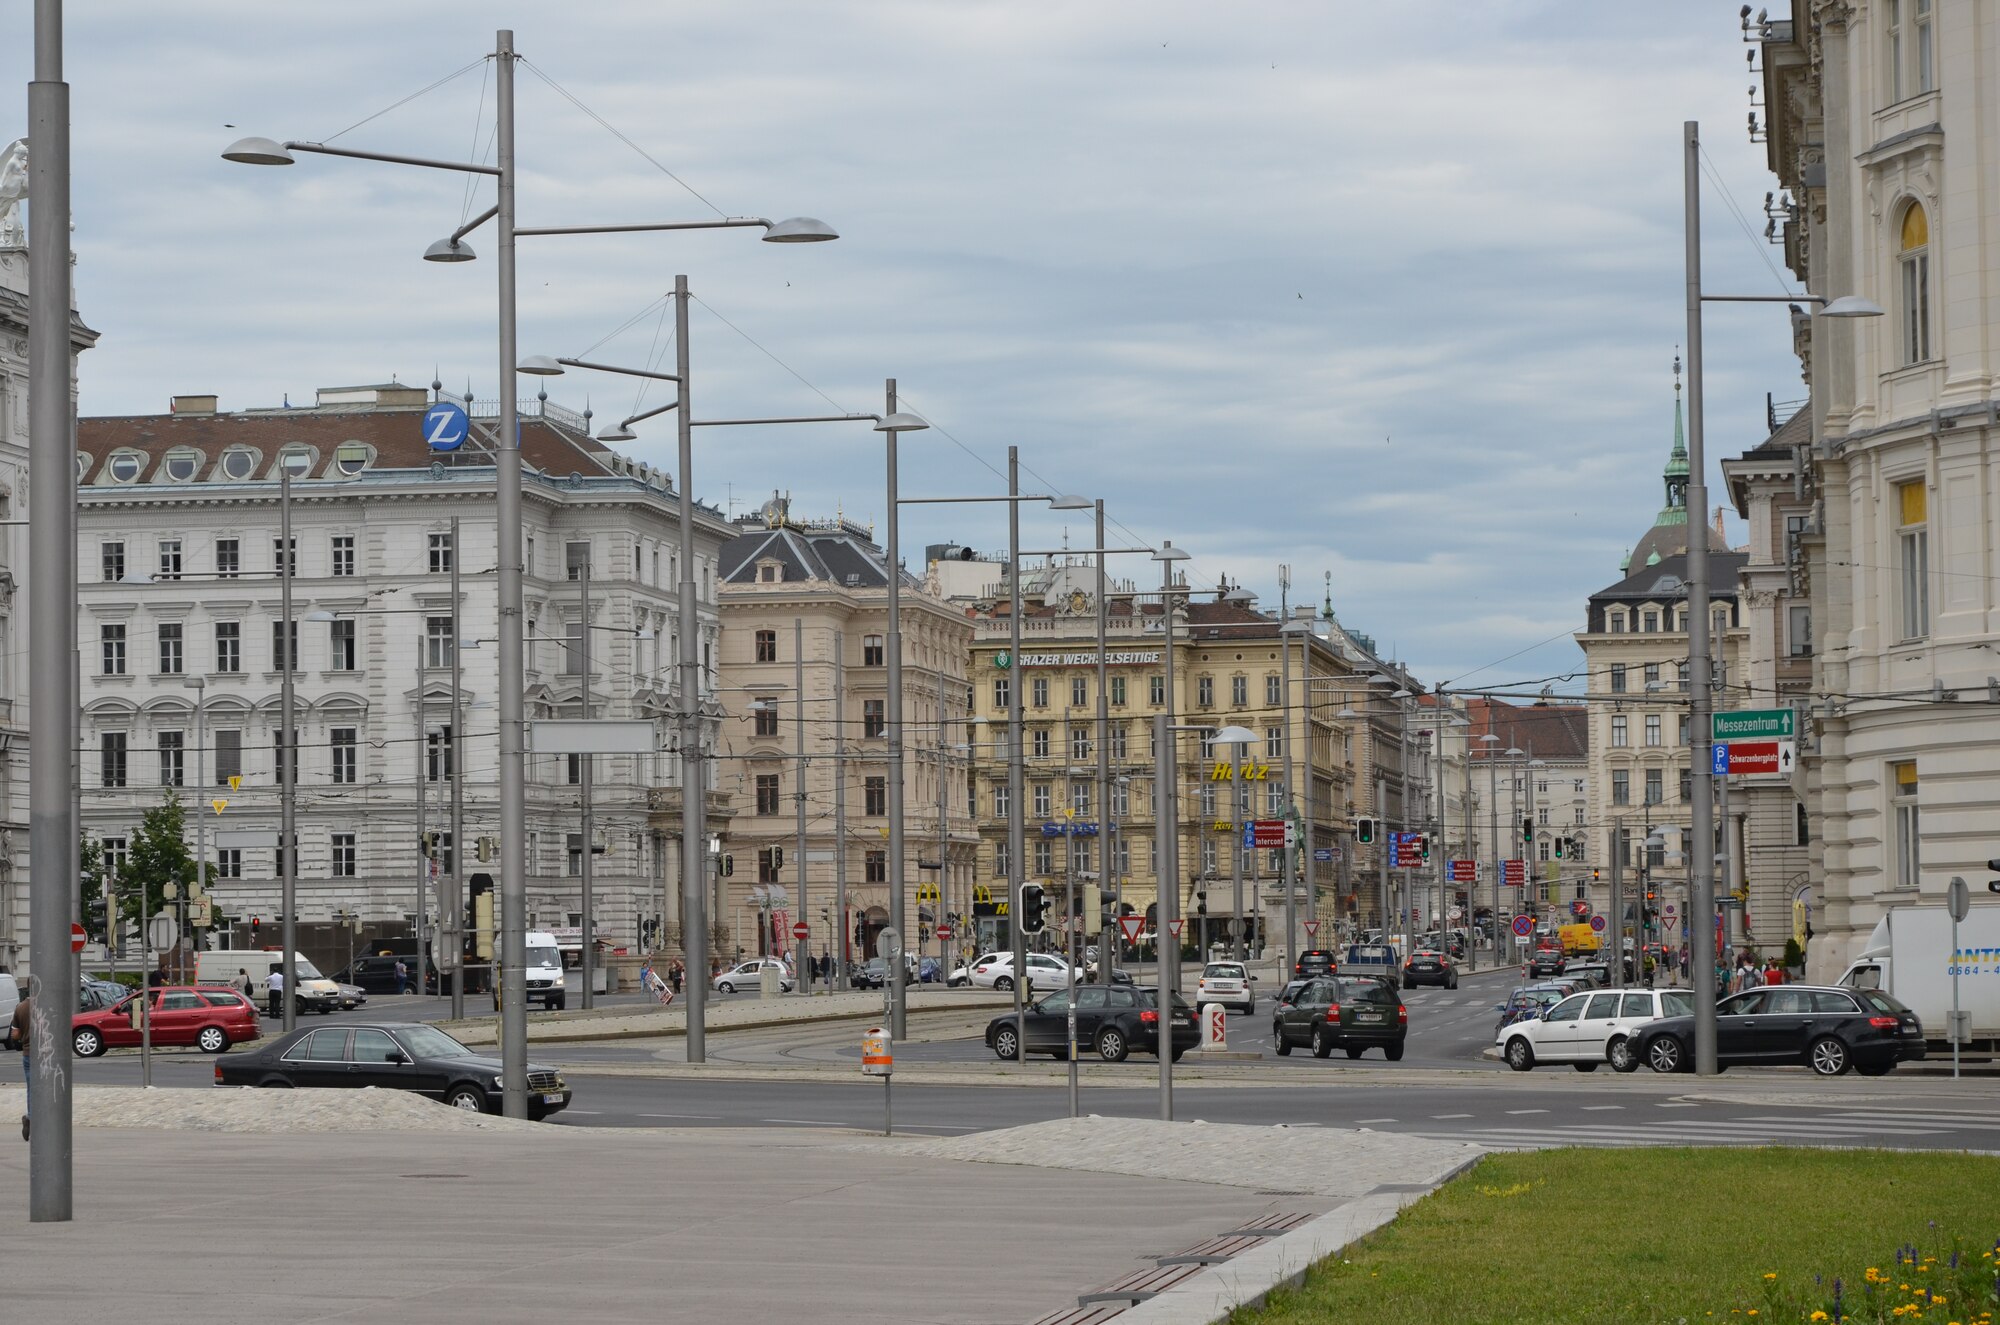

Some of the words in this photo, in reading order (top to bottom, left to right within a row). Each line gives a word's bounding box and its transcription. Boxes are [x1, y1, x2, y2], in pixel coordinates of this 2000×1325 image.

[427, 410, 461, 443] Z
[1716, 716, 1778, 733] Messezentrum
[1729, 754, 1778, 764] Schwarzenbergplatz
[1211, 762, 1269, 780] Hertz
[1255, 837, 1284, 845] Intercont
